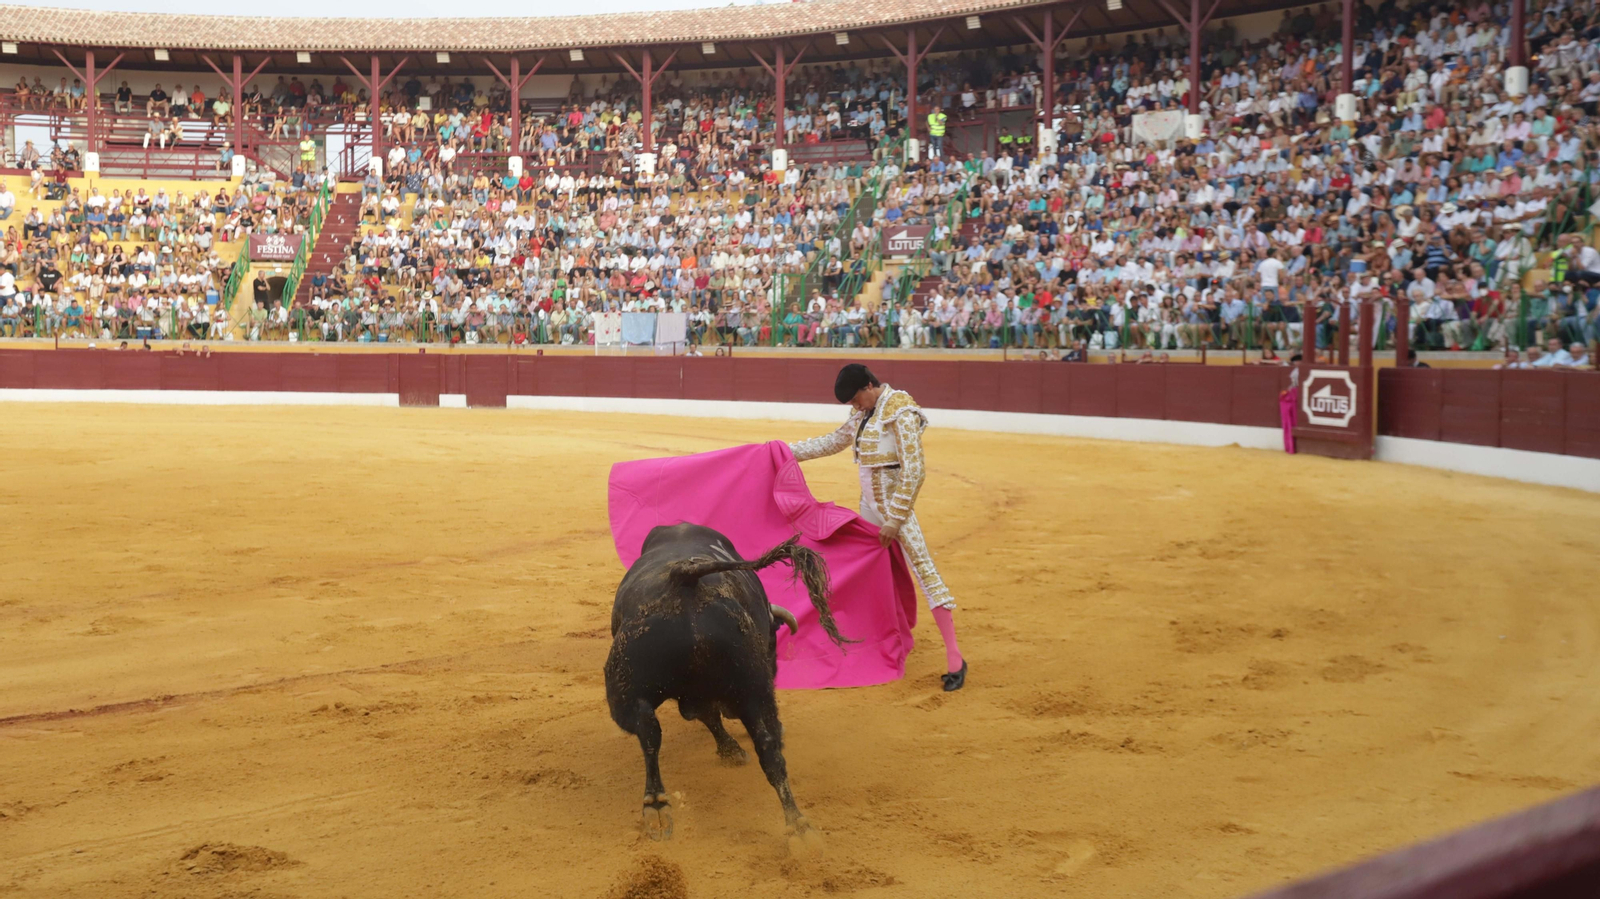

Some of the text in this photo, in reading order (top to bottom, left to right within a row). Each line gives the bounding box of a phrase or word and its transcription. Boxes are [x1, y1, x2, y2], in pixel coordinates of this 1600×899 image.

[257, 245, 295, 254] FESTINA
[888, 240, 924, 250] LOTUS
[1311, 398, 1348, 414] LOTUS
